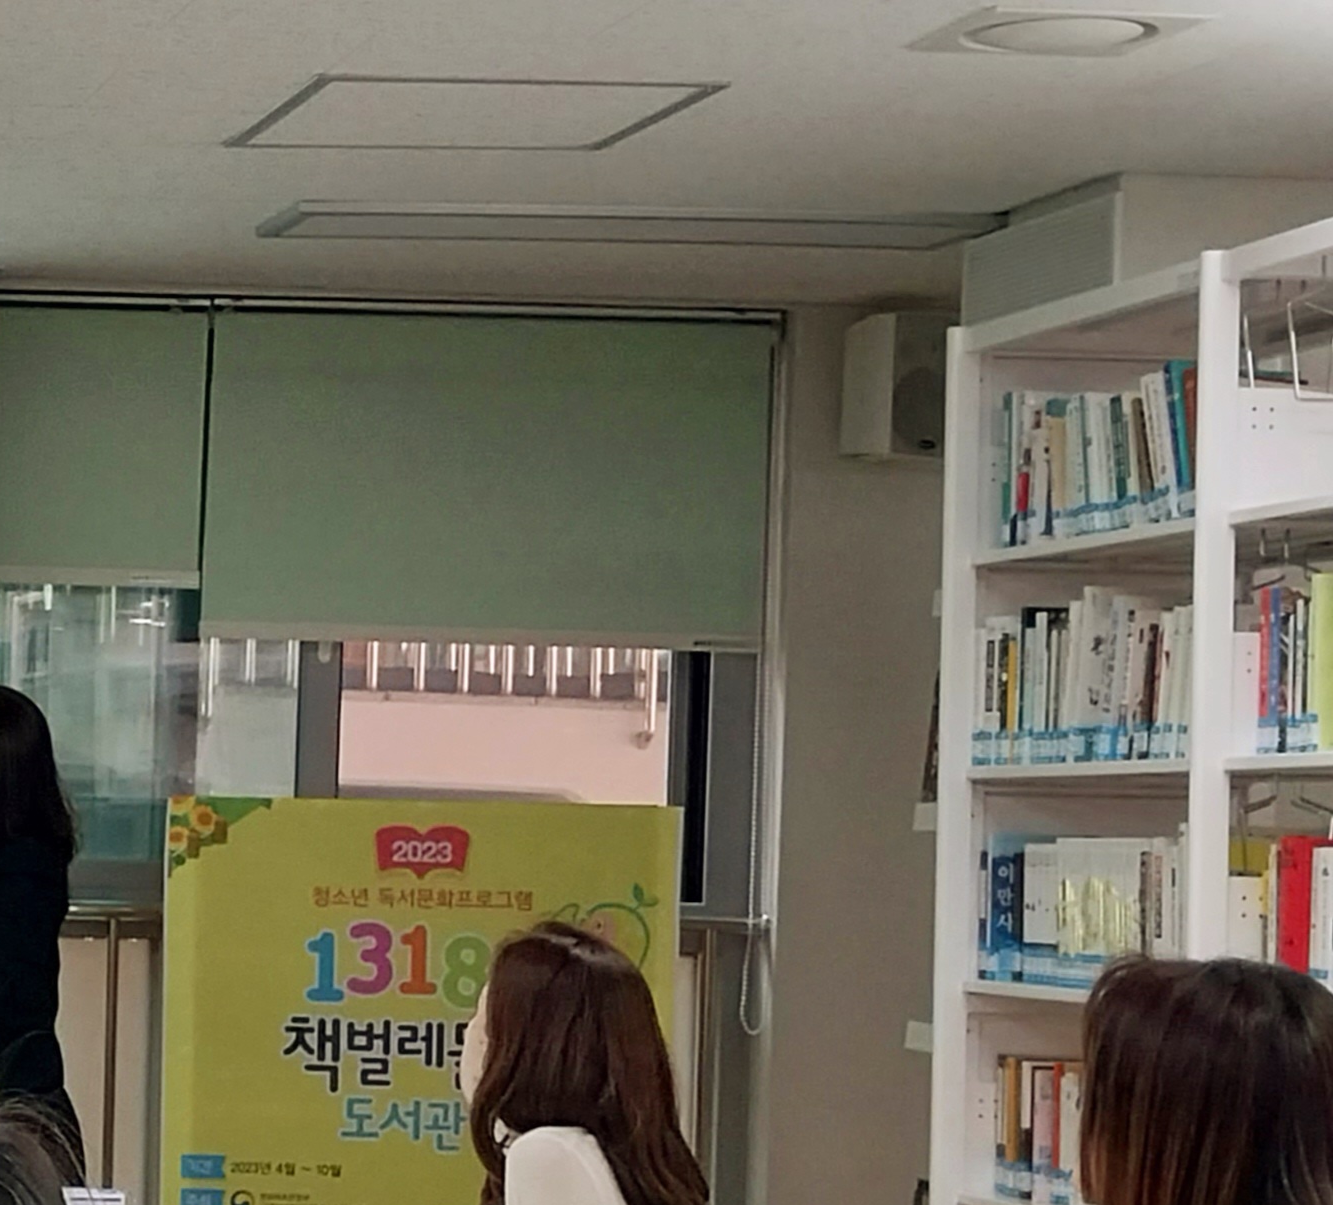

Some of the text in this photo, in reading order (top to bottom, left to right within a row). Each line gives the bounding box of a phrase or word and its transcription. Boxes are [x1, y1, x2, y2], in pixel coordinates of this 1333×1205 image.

[391, 840, 453, 864] 2023
[312, 886, 533, 911] 청소년 독서문화프로그램
[305, 921, 491, 1008] 1318
[340, 1096, 467, 1151] 도서관
[230, 1161, 272, 1176] 2023년
[276, 1162, 296, 1177] 4월
[316, 1164, 342, 1178] 10월
